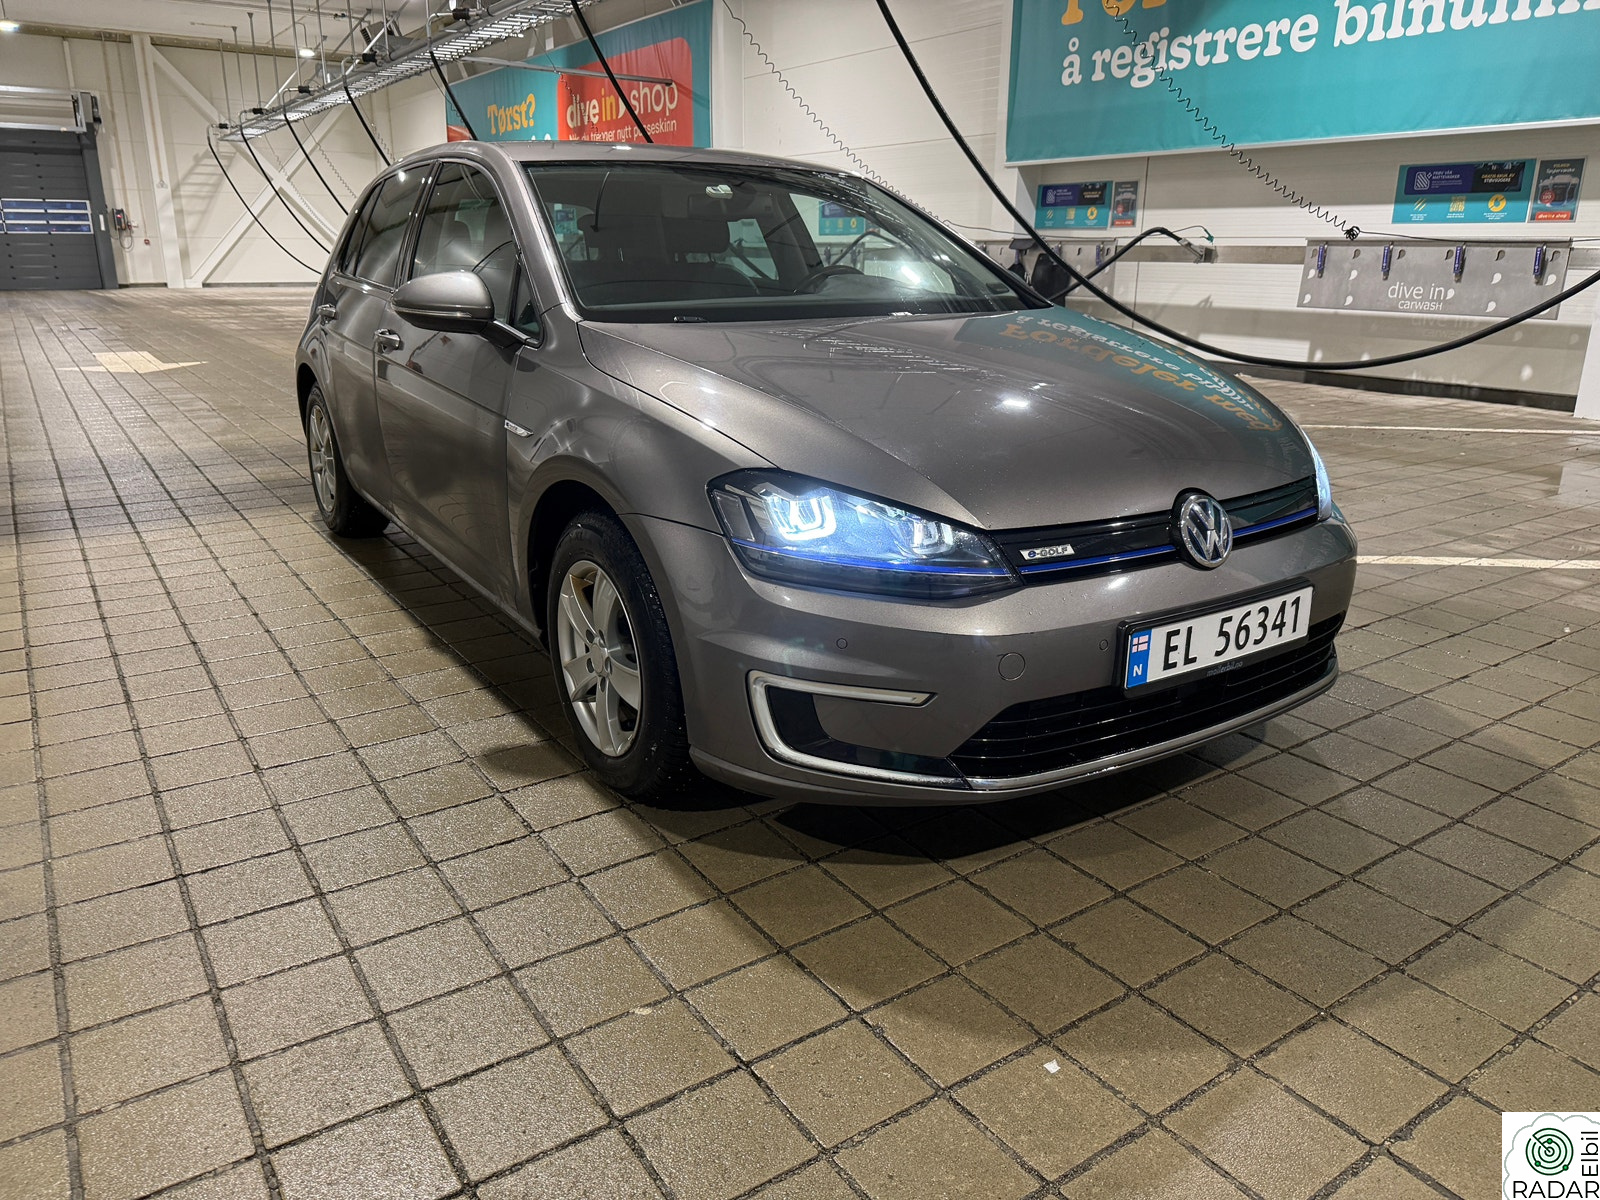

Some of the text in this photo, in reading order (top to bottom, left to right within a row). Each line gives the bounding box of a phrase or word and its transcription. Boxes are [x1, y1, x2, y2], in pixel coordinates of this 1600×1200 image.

[1061, 37, 1082, 86] å
[1091, 26, 1317, 88] registrere
[488, 93, 536, 136] Tørst?
[567, 81, 678, 128] dive in shop
[634, 118, 677, 141] puseskinn
[1388, 281, 1445, 300] dive in
[1163, 596, 1301, 671] EL 56341
[1132, 664, 1143, 677] N
